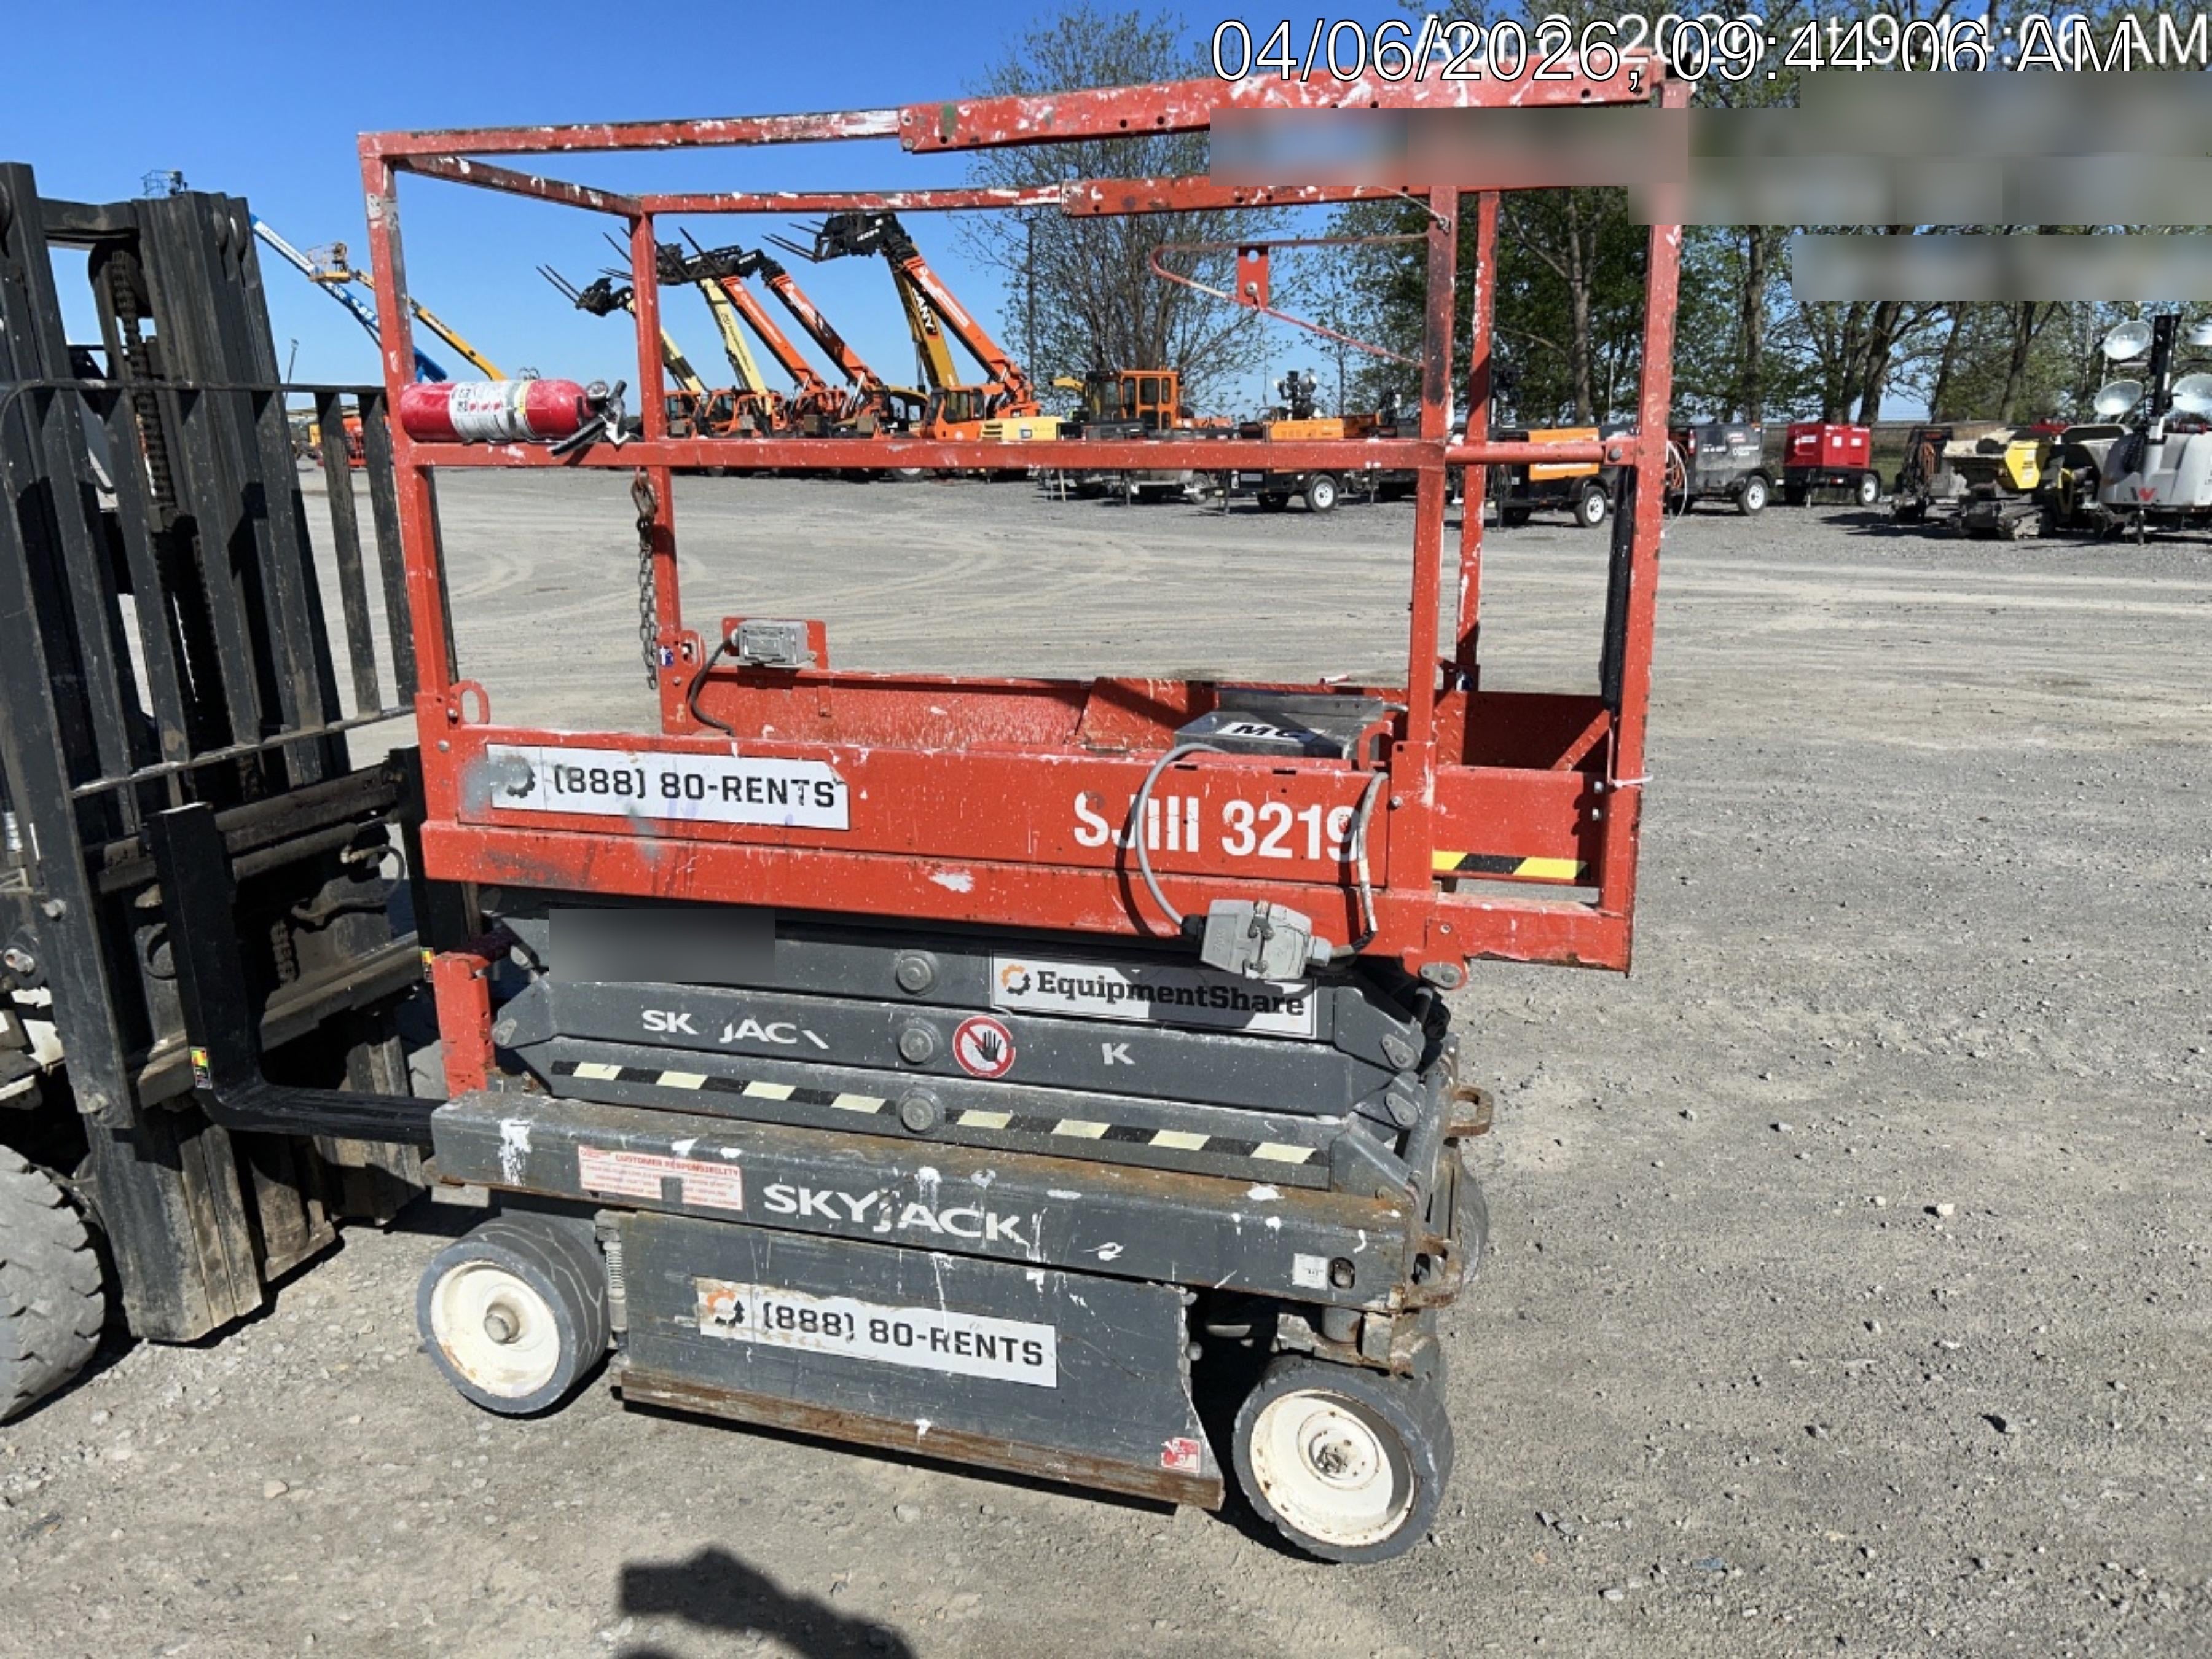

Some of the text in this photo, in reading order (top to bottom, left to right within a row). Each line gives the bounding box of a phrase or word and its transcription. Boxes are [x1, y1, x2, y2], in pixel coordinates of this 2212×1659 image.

[554, 764, 836, 809] (888) 80-RENTS
[1221, 799, 1360, 863] 3219
[1037, 970, 1304, 1016] EquipmentShare
[763, 1183, 1030, 1247] SKYJACK
[762, 1301, 1044, 1367] (888) 80-RENTS
